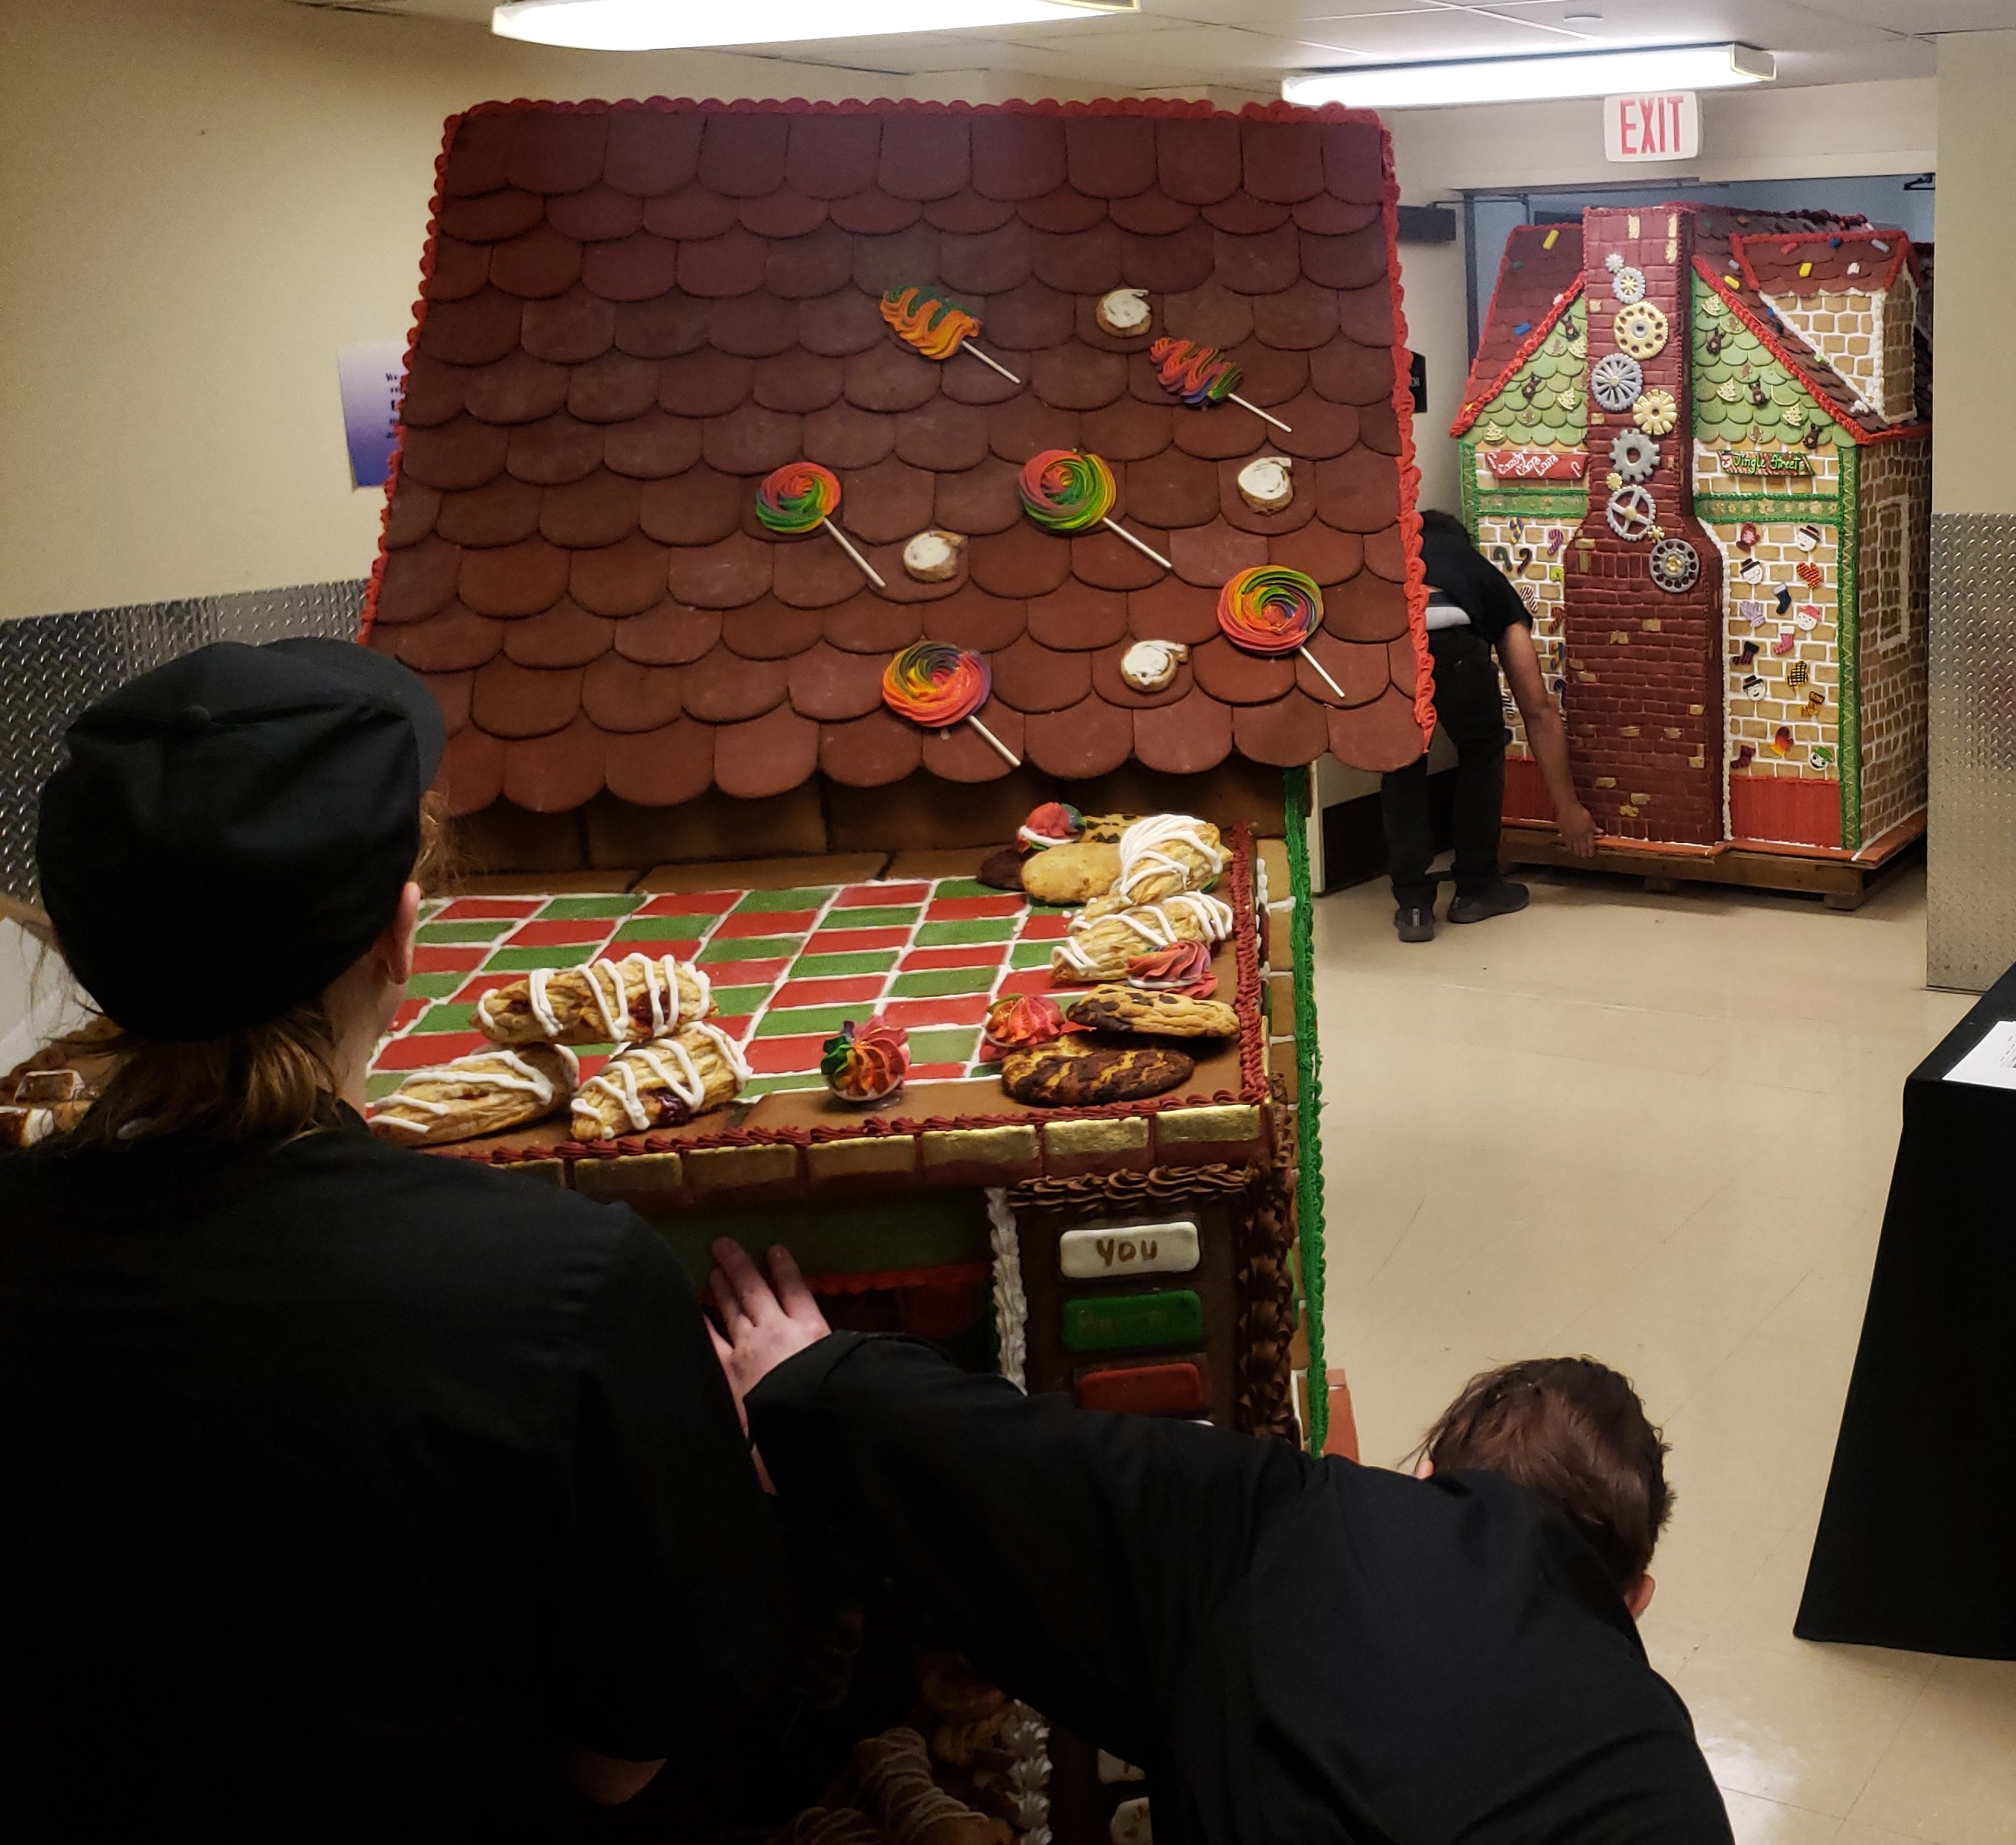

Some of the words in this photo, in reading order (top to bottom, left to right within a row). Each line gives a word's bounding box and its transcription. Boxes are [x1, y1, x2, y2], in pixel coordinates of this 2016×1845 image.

[1620, 96, 1684, 155] EXIT
[1497, 452, 1526, 475] Candy
[1516, 456, 1542, 476] Cane
[1534, 455, 1559, 477] Lane
[1733, 454, 1765, 474] Jingle
[1771, 454, 1801, 470] Street
